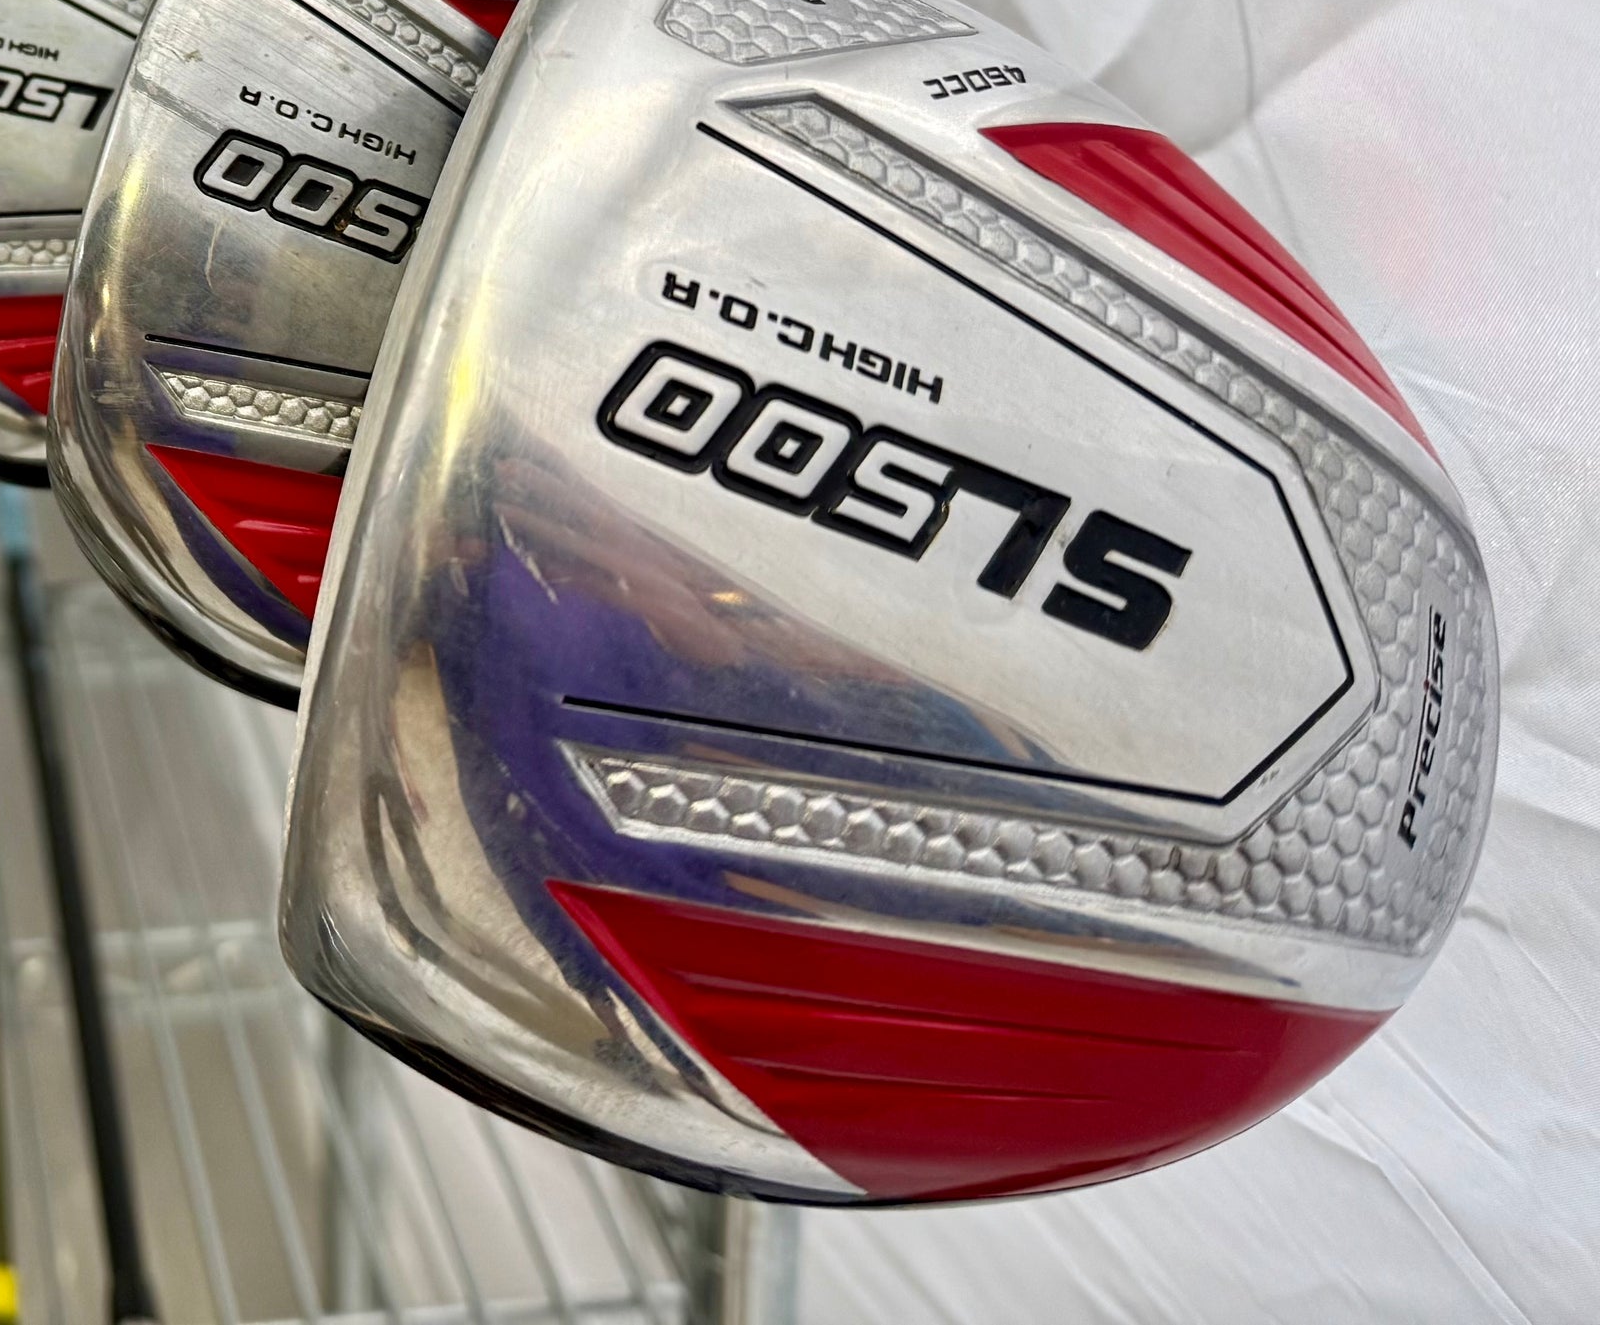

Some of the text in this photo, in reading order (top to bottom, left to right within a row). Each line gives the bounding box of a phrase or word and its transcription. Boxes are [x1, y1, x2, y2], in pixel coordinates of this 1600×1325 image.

[923, 65, 1027, 100] 460CC
[338, 123, 416, 165] HIGH
[820, 336, 944, 405] HIGH
[598, 341, 1193, 652] SL500
[1397, 606, 1448, 850] Precise
